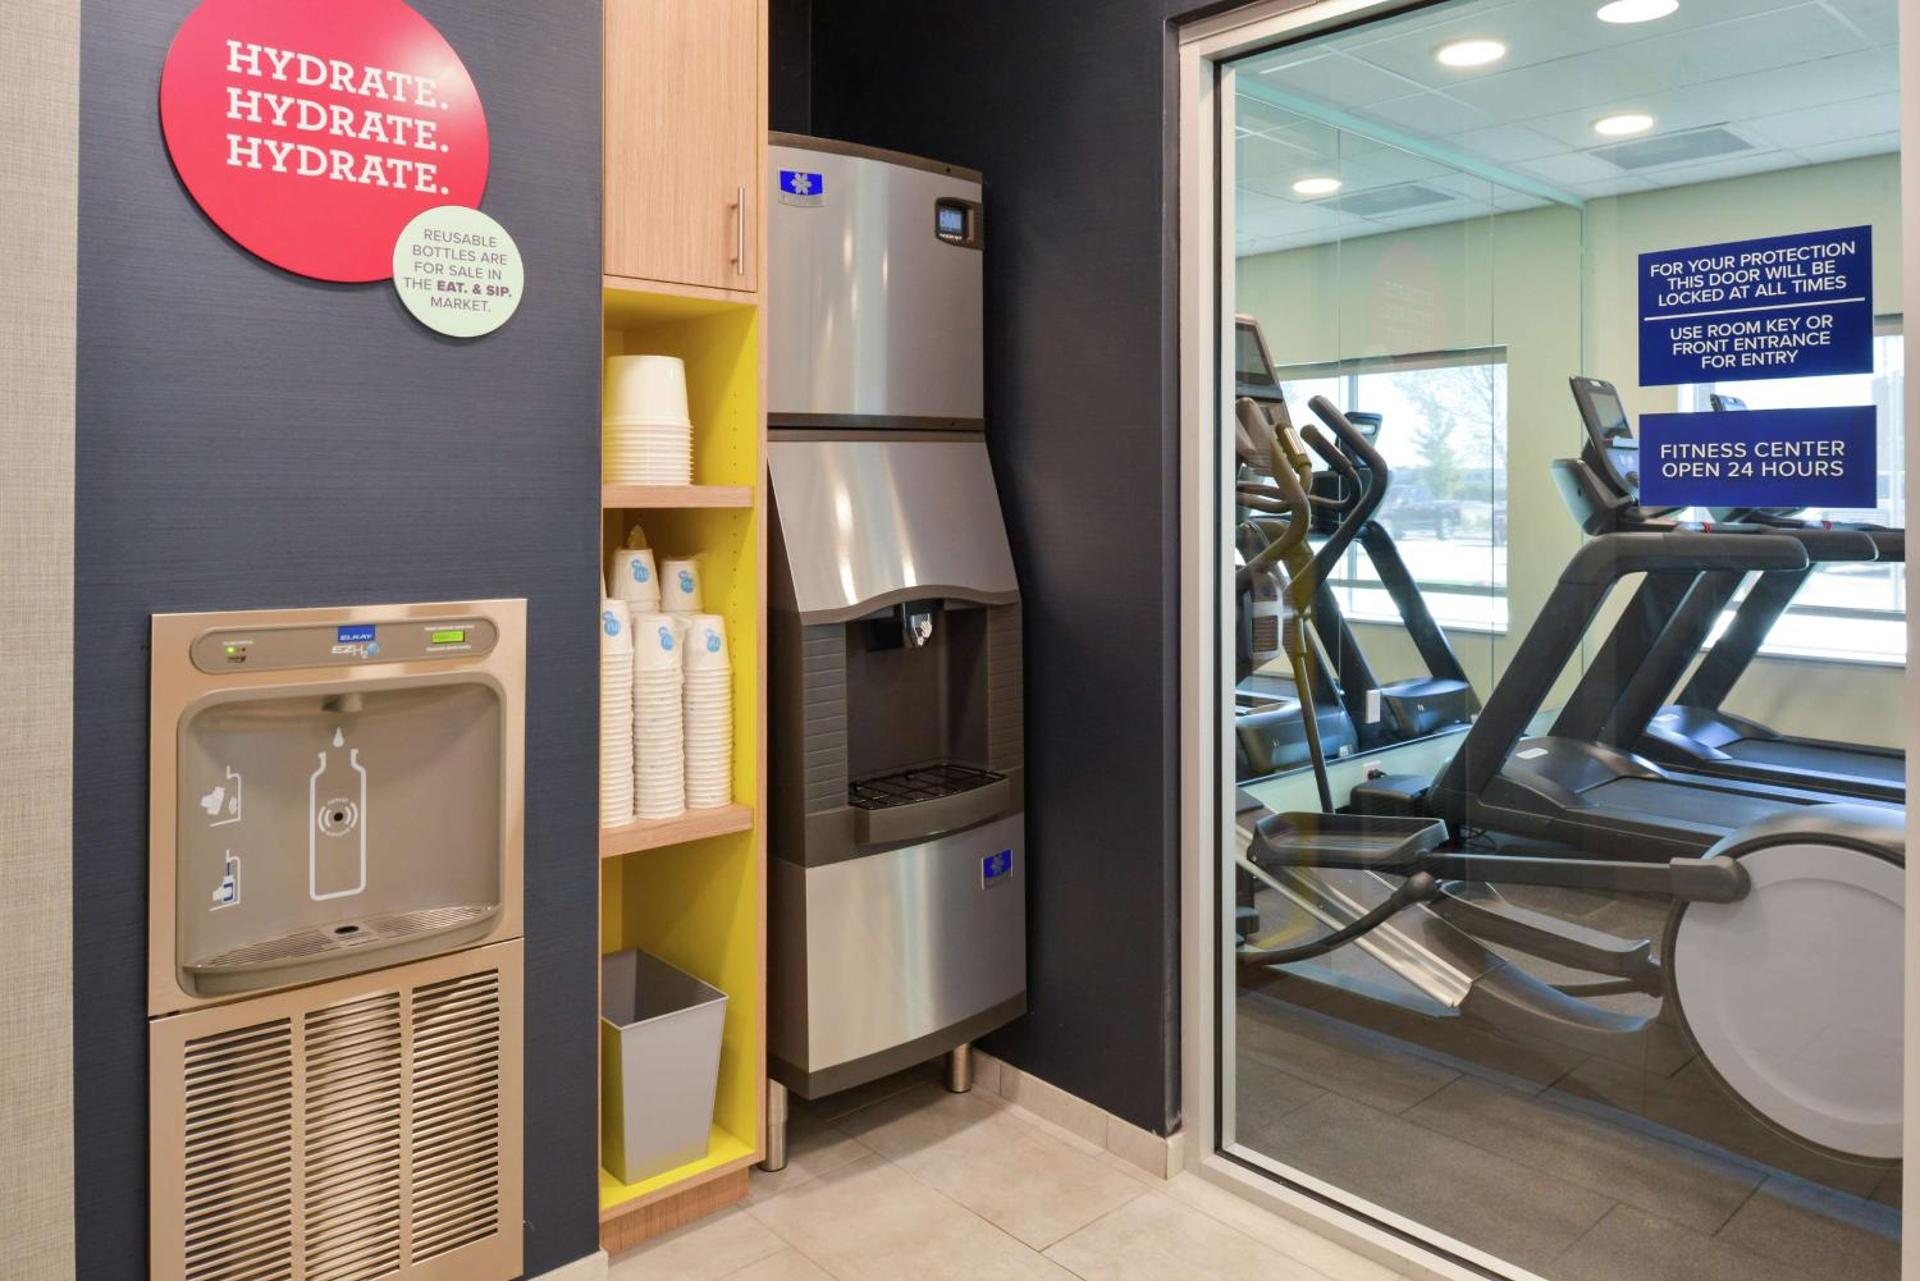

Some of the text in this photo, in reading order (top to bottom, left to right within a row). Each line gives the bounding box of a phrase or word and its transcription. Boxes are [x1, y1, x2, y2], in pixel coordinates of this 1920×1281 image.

[226, 39, 449, 110] HYDRATE.
[226, 87, 449, 153] HYDRATE.
[226, 134, 449, 195] HYDRATE.
[424, 228, 497, 249] REUSABLE
[412, 244, 508, 266] BOTTLES ARE
[1650, 241, 1856, 277] FOR YOUR PROTECTION
[414, 261, 502, 281] FOR SALE IN
[1667, 260, 1836, 290] THIS DOOR WILL BE
[404, 276, 512, 298] THE EAT. & SIP.
[1658, 275, 1847, 307] LOCKED AT ALL TIMES
[430, 296, 492, 313] MARKET.
[1670, 314, 1834, 340] USE ROOM KEY OR
[1672, 331, 1831, 356] FRONT ENTRANCE
[1701, 349, 1799, 369] FOR ENTRY
[1660, 440, 1846, 459] FITNESS CENTER
[1661, 460, 1844, 478] OPEN 24 HOURS
[340, 633, 373, 641] ELKAY
